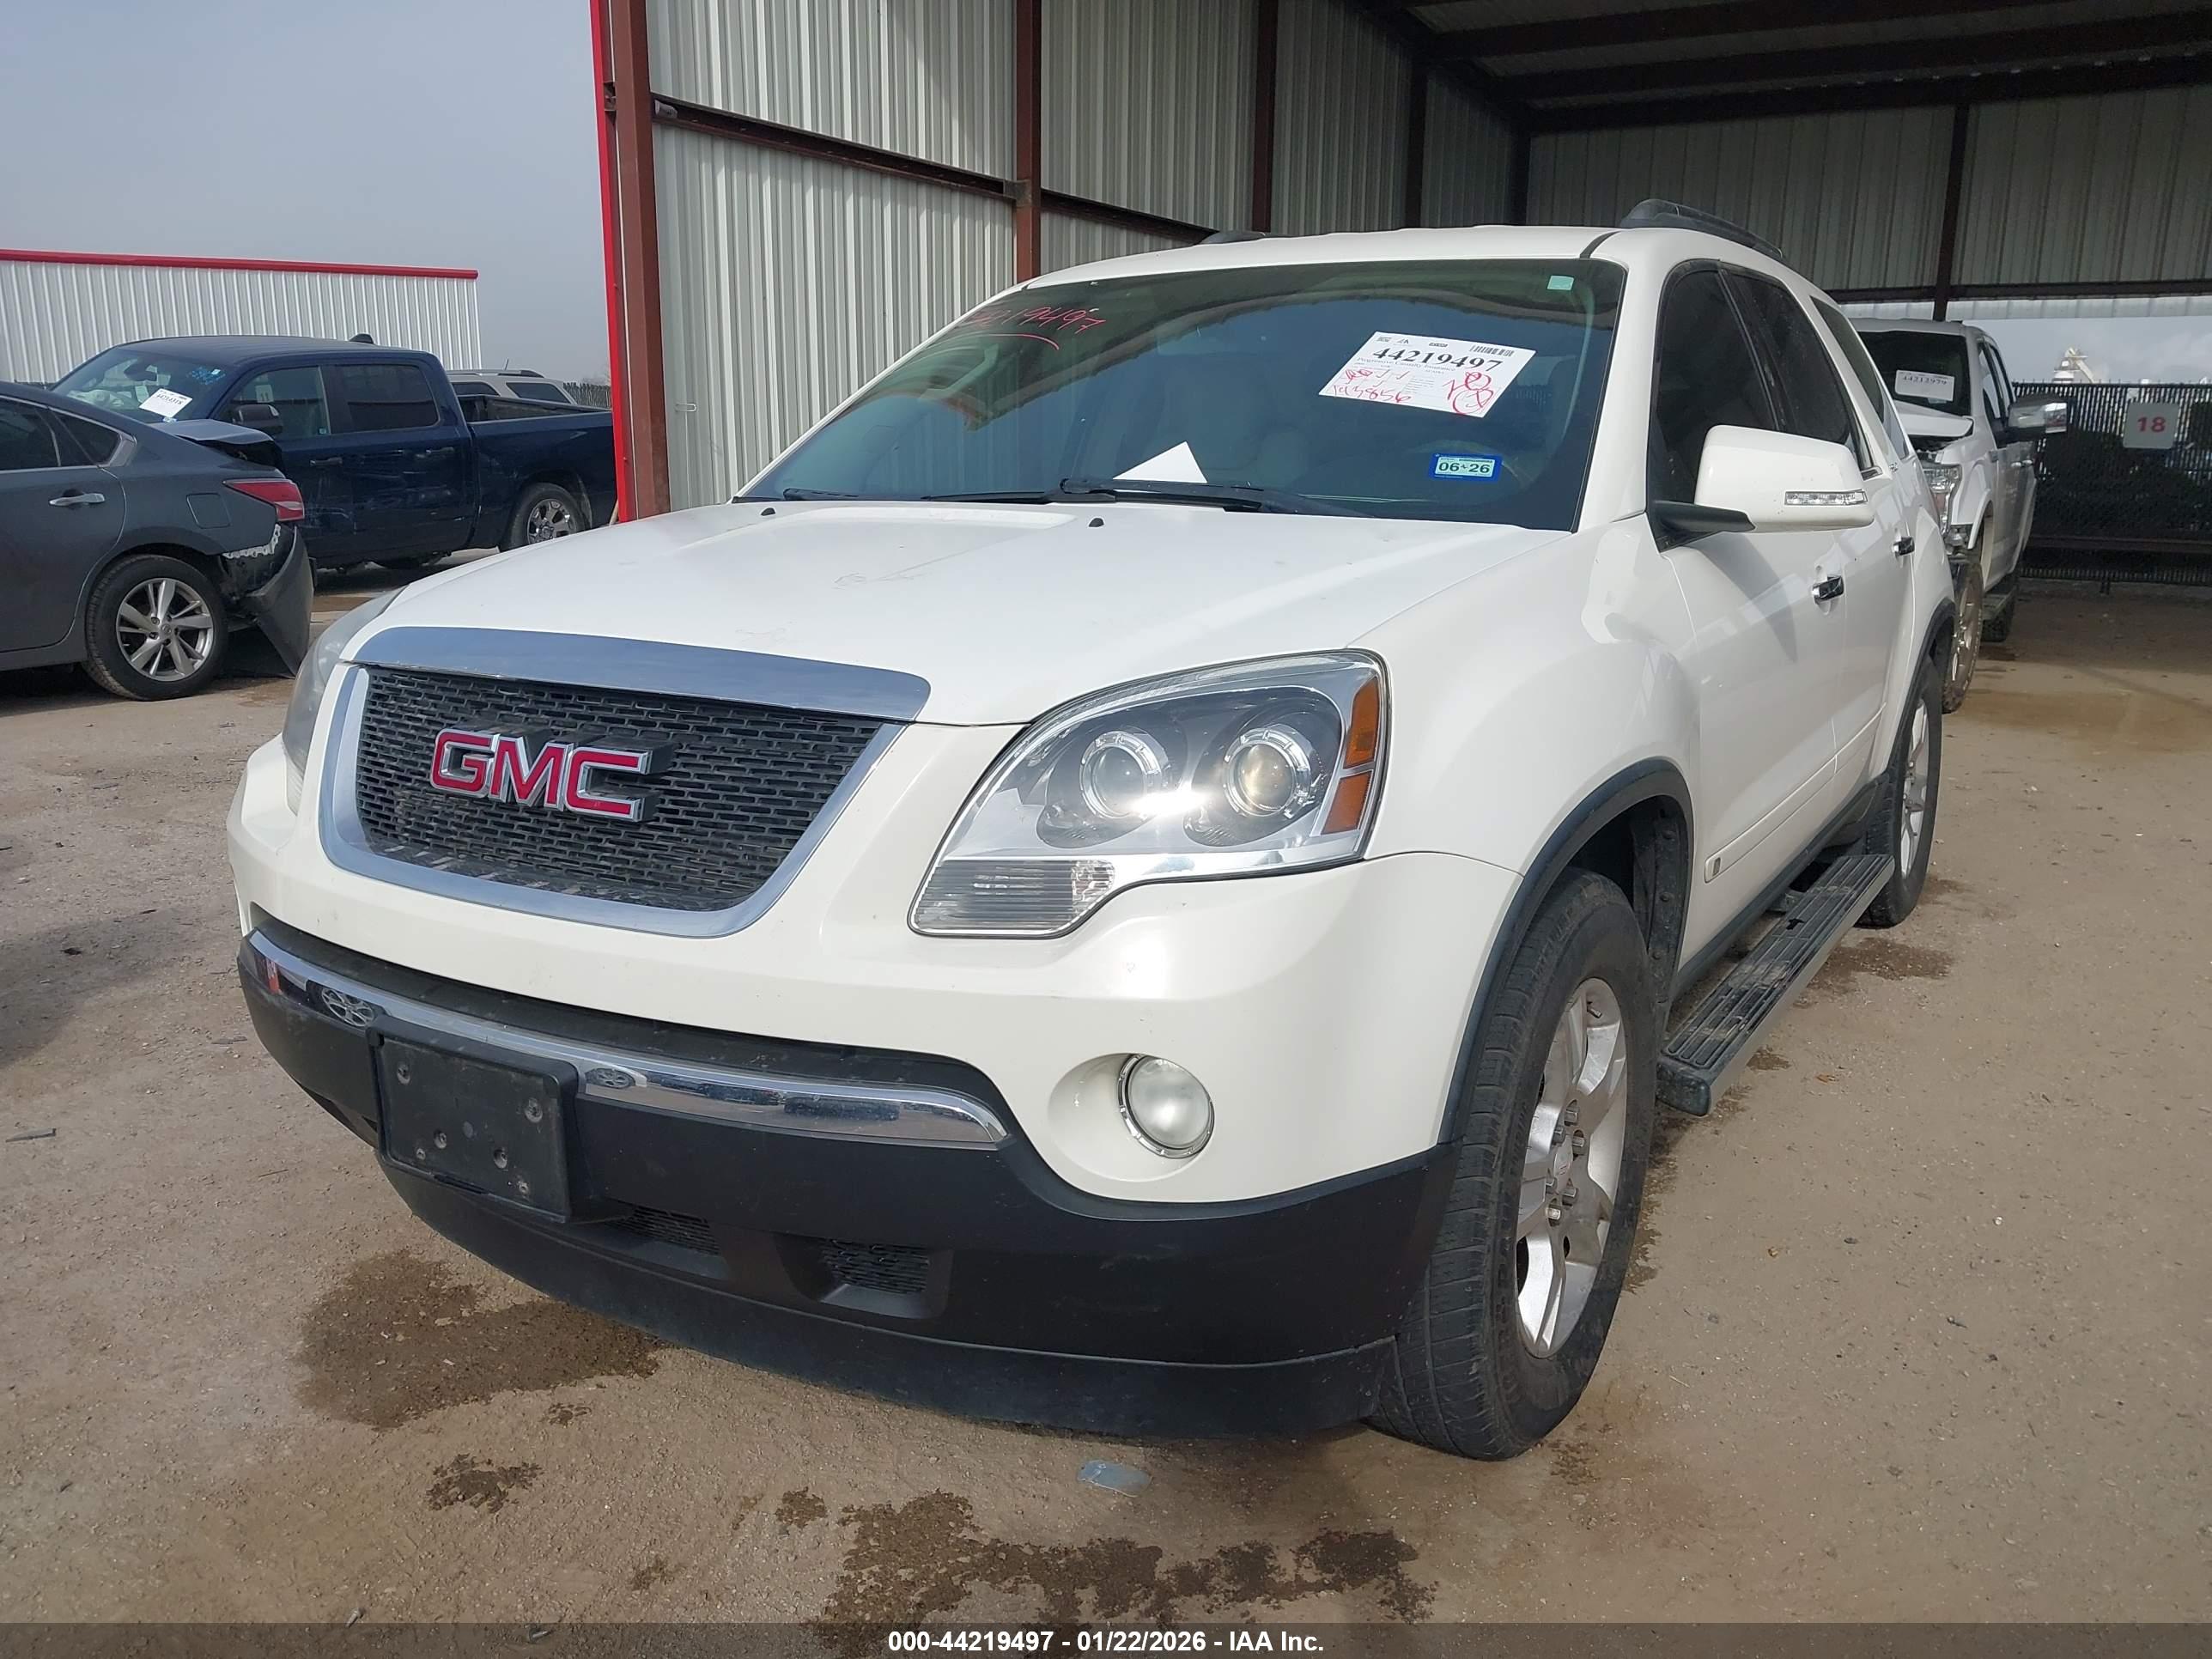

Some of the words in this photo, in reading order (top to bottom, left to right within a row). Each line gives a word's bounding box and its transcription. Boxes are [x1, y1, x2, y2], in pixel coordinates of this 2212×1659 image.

[1373, 348, 1503, 372] 44219497
[2137, 416, 2166, 433] 18
[1438, 462, 1460, 472] 06
[1468, 464, 1490, 473] 26
[430, 728, 650, 822] GMC
